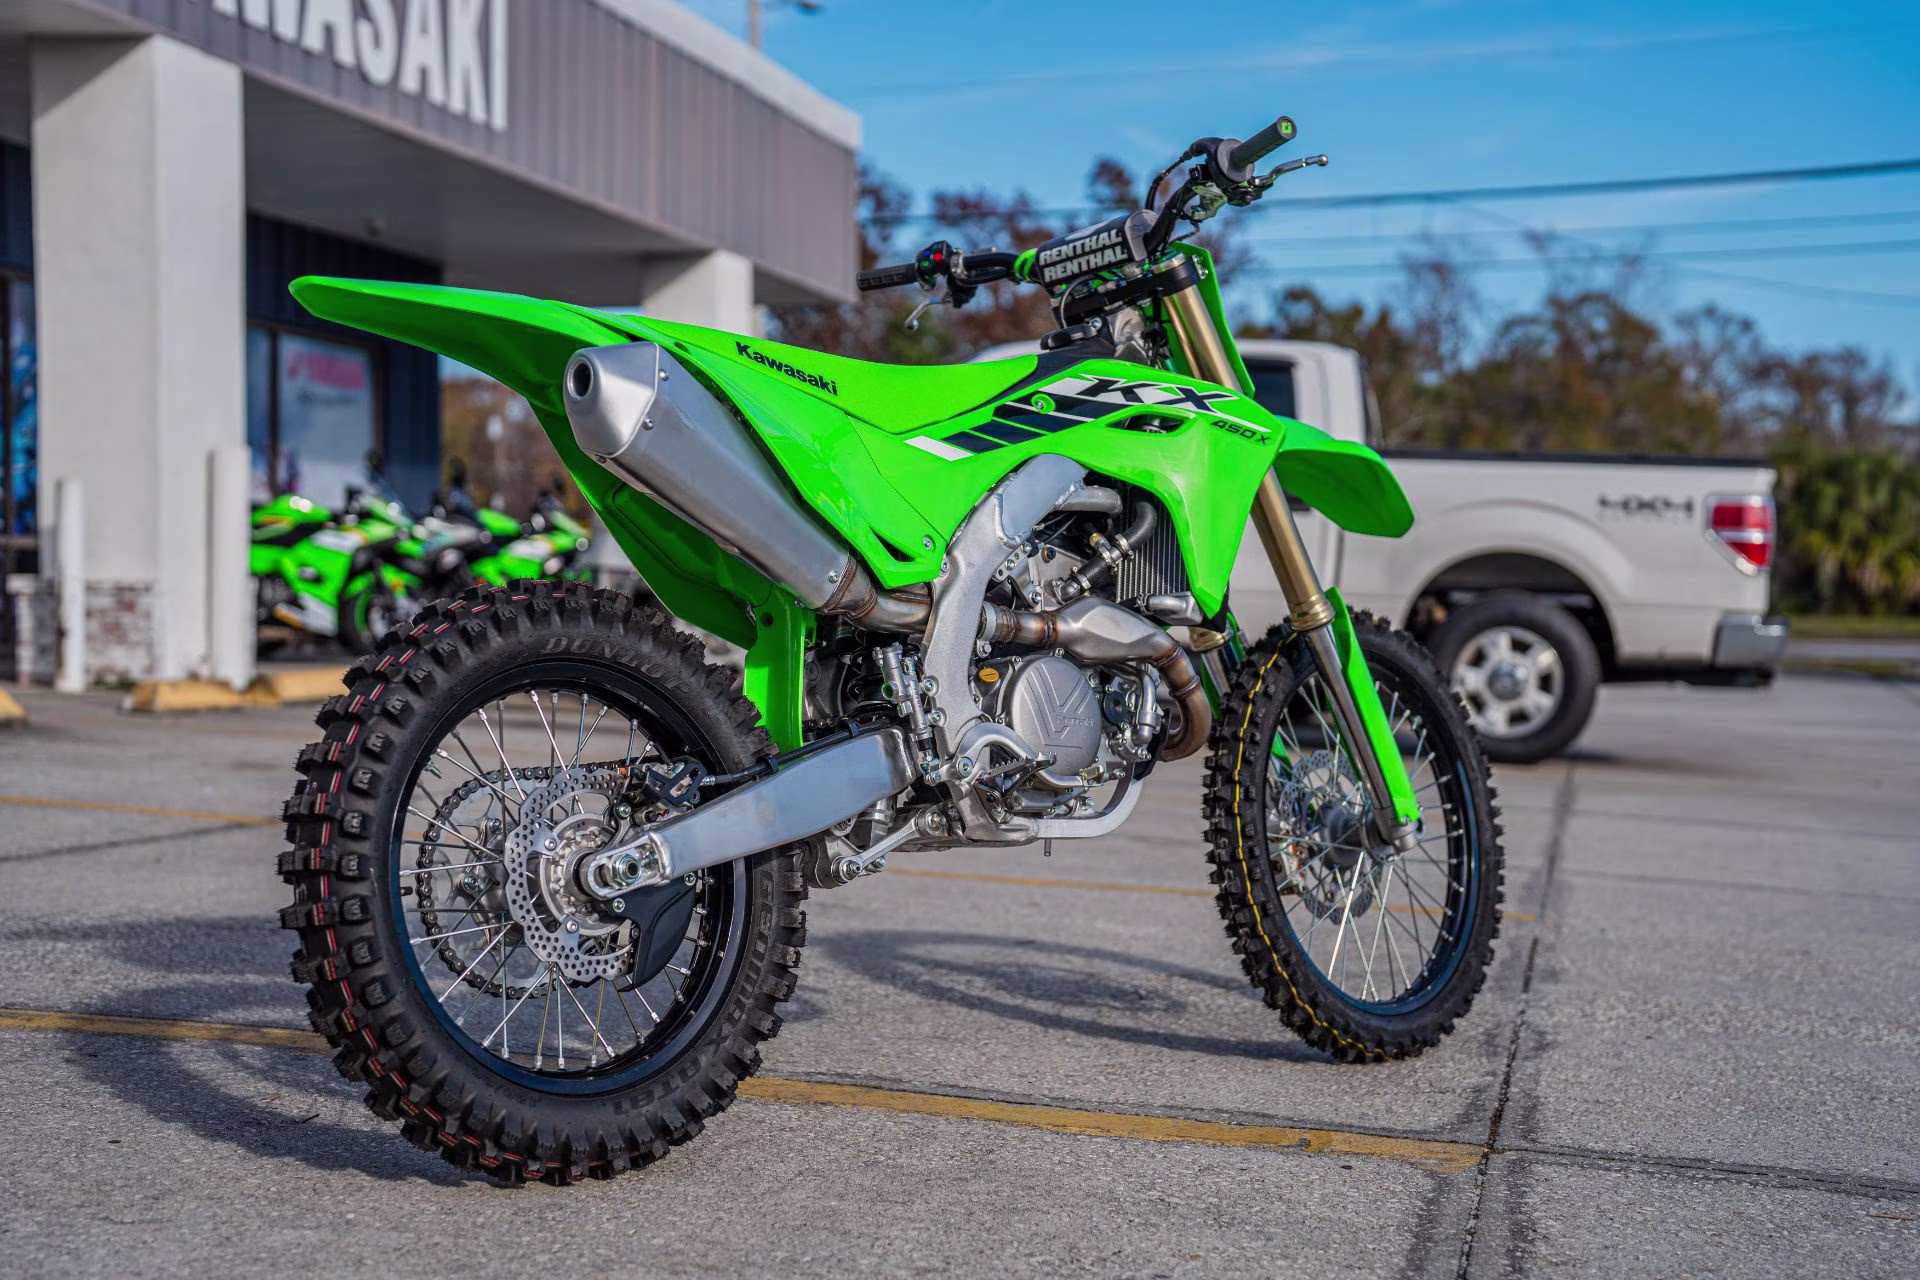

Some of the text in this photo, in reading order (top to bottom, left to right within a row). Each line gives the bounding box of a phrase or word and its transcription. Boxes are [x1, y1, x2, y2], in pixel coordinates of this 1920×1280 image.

[1039, 228, 1122, 266] RENTHAL
[1043, 245, 1128, 282] RENTHAL
[736, 341, 838, 396] Kawasaki
[1075, 375, 1238, 414] KX
[540, 636, 692, 693] DUNLOP
